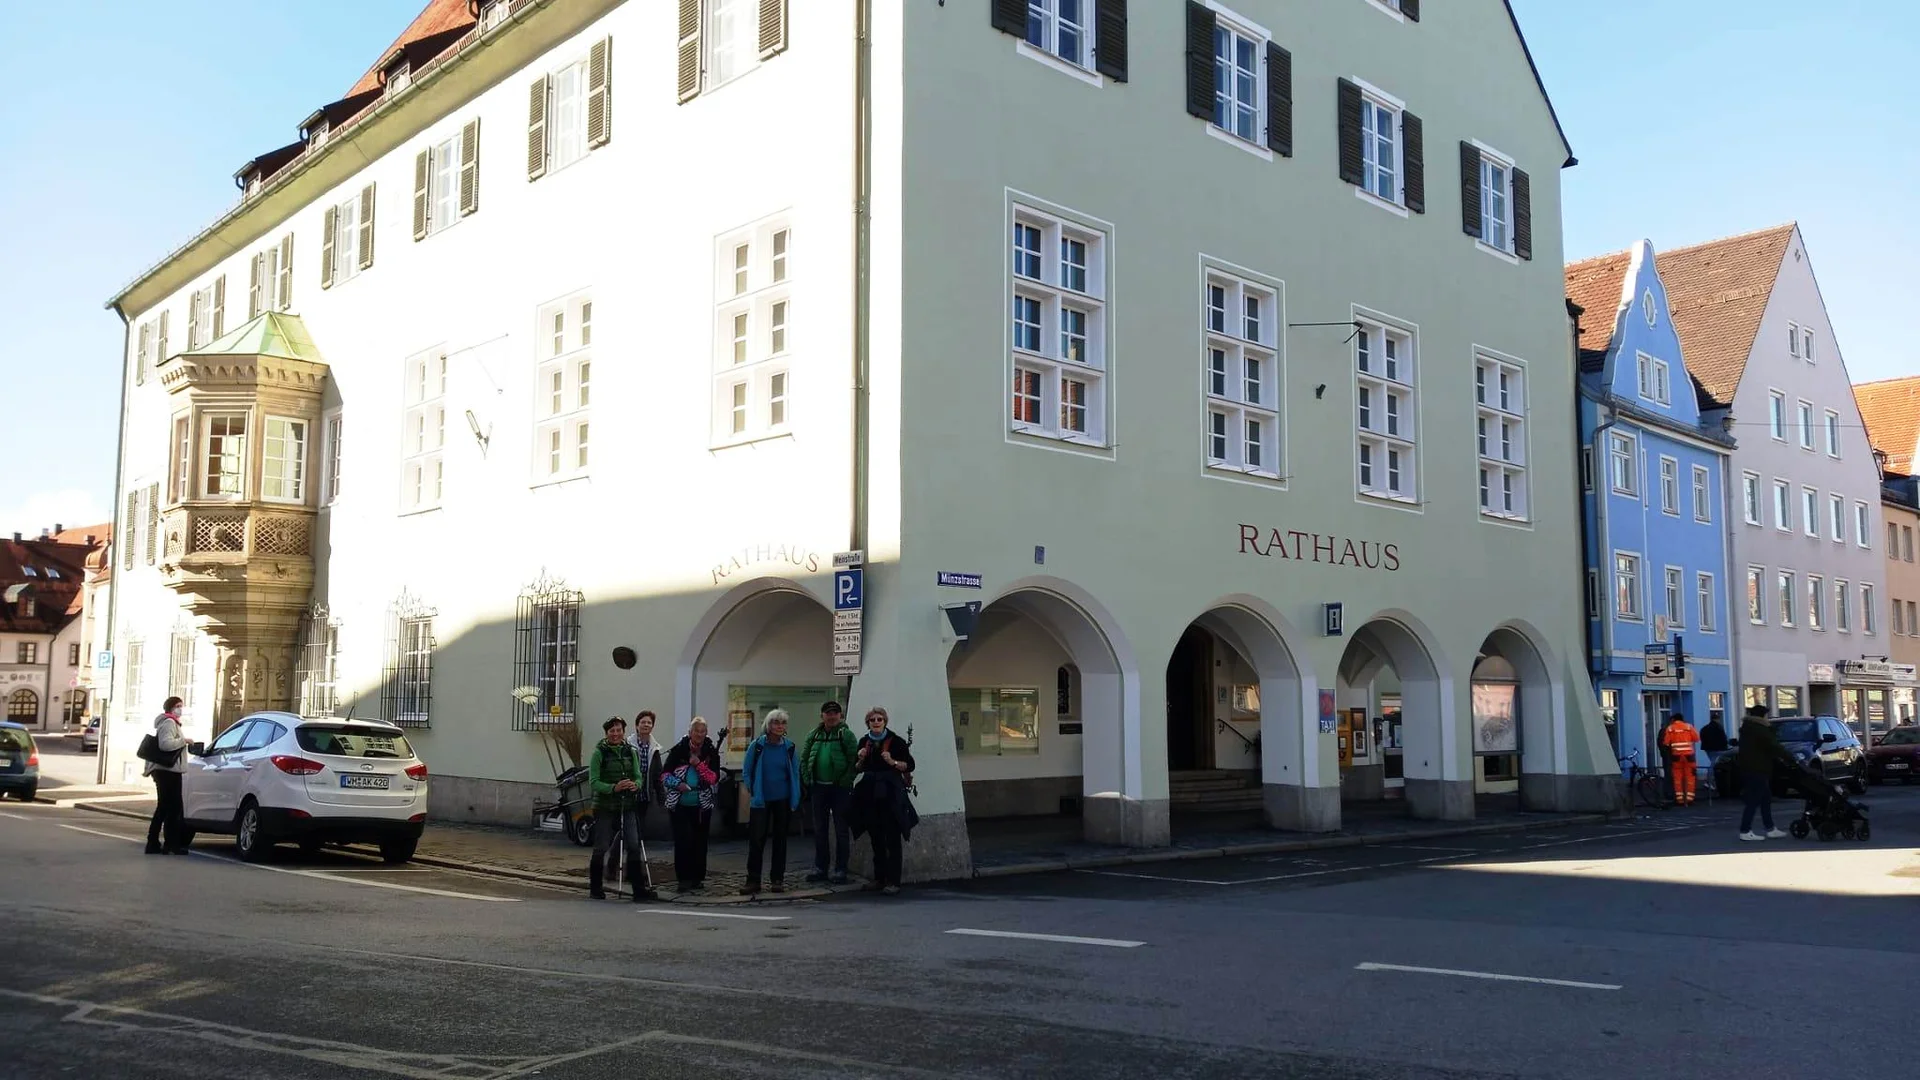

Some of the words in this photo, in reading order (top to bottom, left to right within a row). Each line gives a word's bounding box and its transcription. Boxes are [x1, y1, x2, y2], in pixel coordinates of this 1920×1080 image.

[1238, 523, 1400, 571] RATHAUS
[711, 543, 820, 586] RATHAUS
[941, 573, 980, 586] Münzstrasse
[839, 575, 854, 605] P
[100, 654, 109, 667] P
[1320, 720, 1335, 729] TAXI
[347, 777, 358, 787] WM
[363, 778, 372, 787] AK
[374, 778, 388, 787] 420
